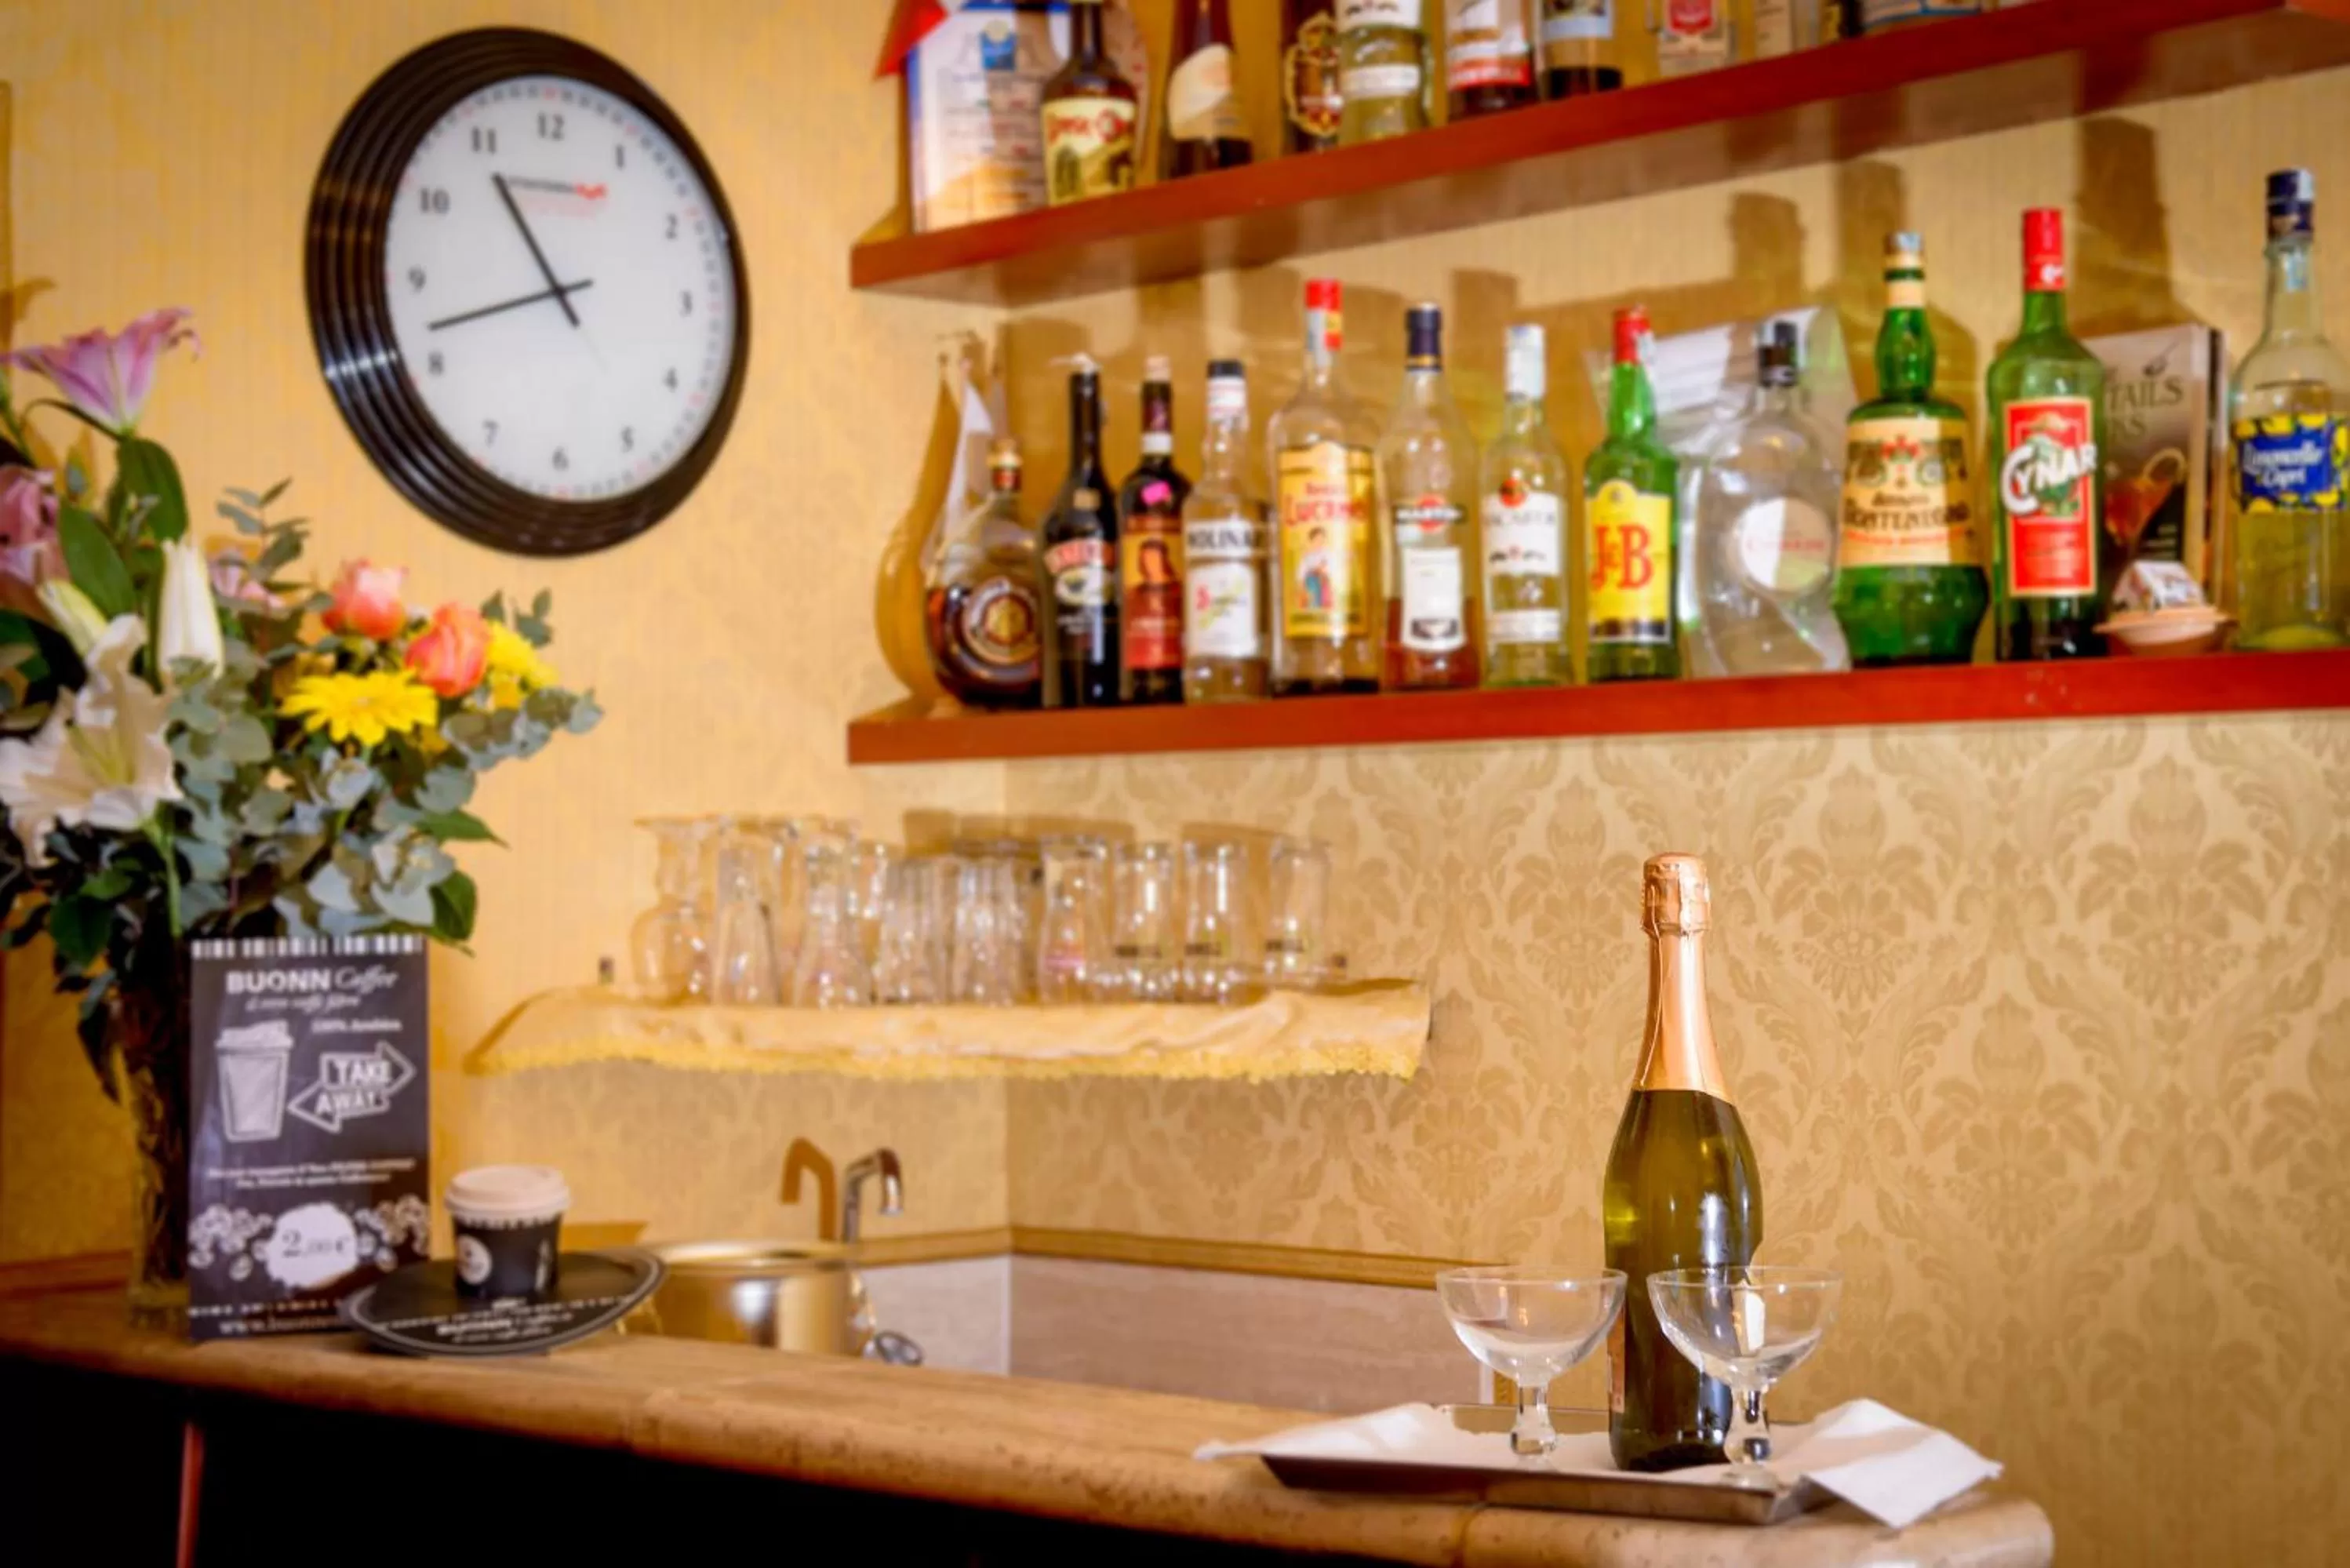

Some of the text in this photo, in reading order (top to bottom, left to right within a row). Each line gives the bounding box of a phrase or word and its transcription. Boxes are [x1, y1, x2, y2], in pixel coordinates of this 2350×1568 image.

[537, 112, 565, 140] 12
[471, 126, 497, 155] 11
[614, 144, 626, 169] 1
[419, 187, 450, 214] 10
[665, 213, 679, 240] 2
[407, 268, 427, 292] 9
[681, 291, 693, 315] 3
[427, 352, 444, 376] 8
[664, 369, 679, 391] 4
[2107, 380, 2184, 413] TAILS
[482, 420, 500, 447] 7
[620, 426, 635, 453] 5
[551, 448, 569, 471] 6
[226, 969, 332, 995] BUONN
[331, 1060, 391, 1086] TAKE
[315, 1090, 382, 1117] AWAY
